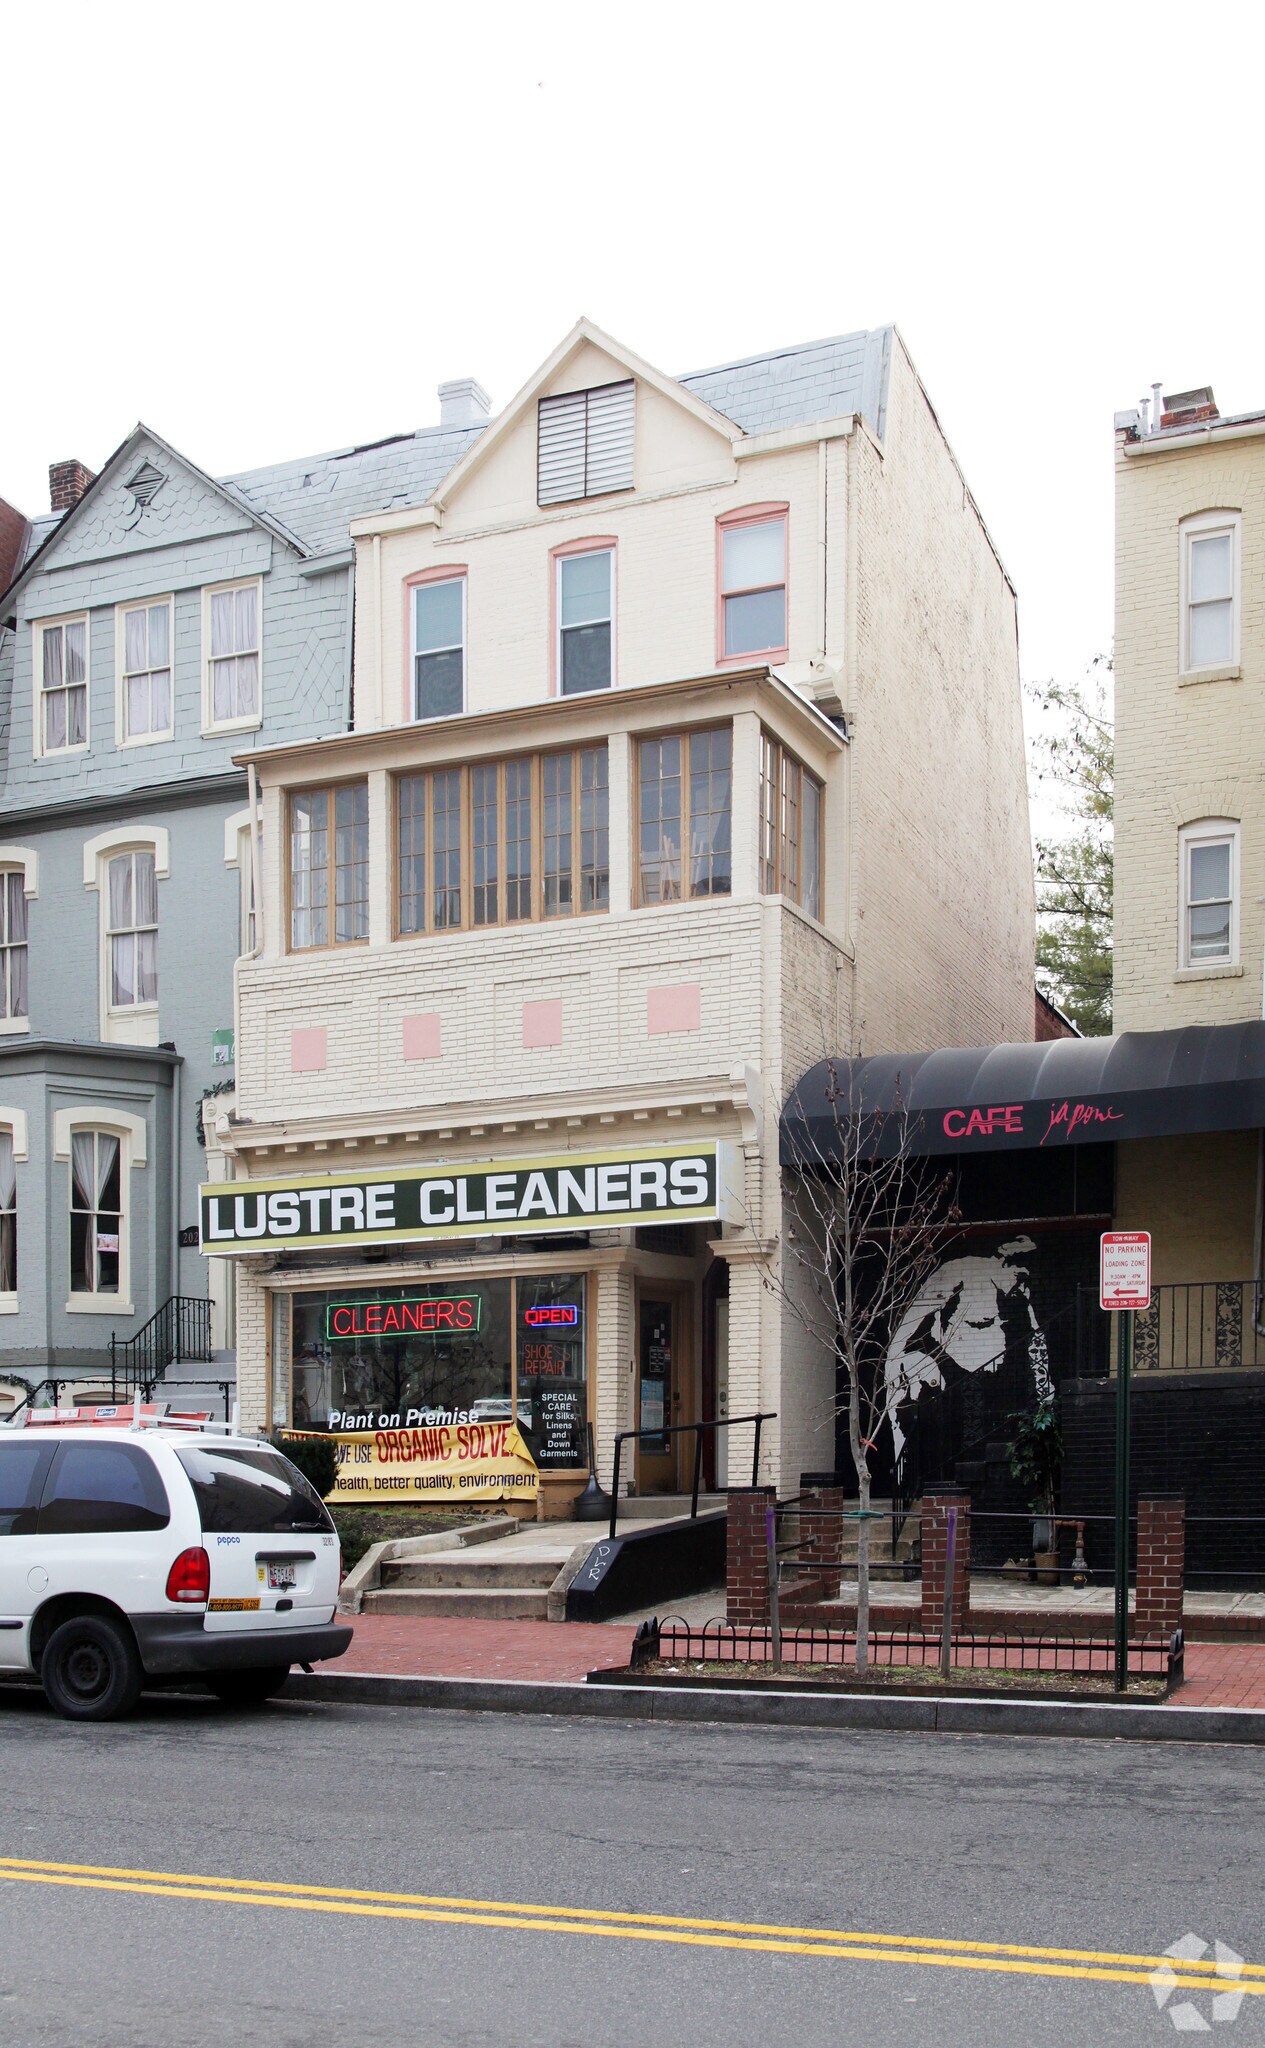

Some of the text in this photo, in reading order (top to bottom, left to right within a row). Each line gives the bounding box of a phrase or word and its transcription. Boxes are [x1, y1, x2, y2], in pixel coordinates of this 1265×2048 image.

[943, 1105, 1024, 1138] CAFE
[208, 1158, 709, 1240] LUSTRE CLEANERS
[1105, 1245, 1147, 1254] NO PARKING
[1105, 1259, 1146, 1268] LOADING ZONE
[333, 1300, 473, 1335] CLEANERS
[525, 1308, 574, 1324] OPEN
[524, 1344, 553, 1360] SHOE
[525, 1360, 566, 1376] REPAIR
[541, 1393, 578, 1402] SPECIAL
[547, 1403, 571, 1411] CARE
[328, 1406, 480, 1430] Plant on Premise
[542, 1412, 577, 1421] for Silks,
[546, 1421, 573, 1429] Linens
[551, 1430, 567, 1439] and
[336, 1422, 514, 1464] WE USE ORGANIC SOLVE
[547, 1440, 571, 1448] Down
[539, 1449, 578, 1457] Garments
[374, 1475, 411, 1490] better
[414, 1474, 455, 1492] quality,
[459, 1472, 537, 1489] environment
[217, 1536, 241, 1546] pepco
